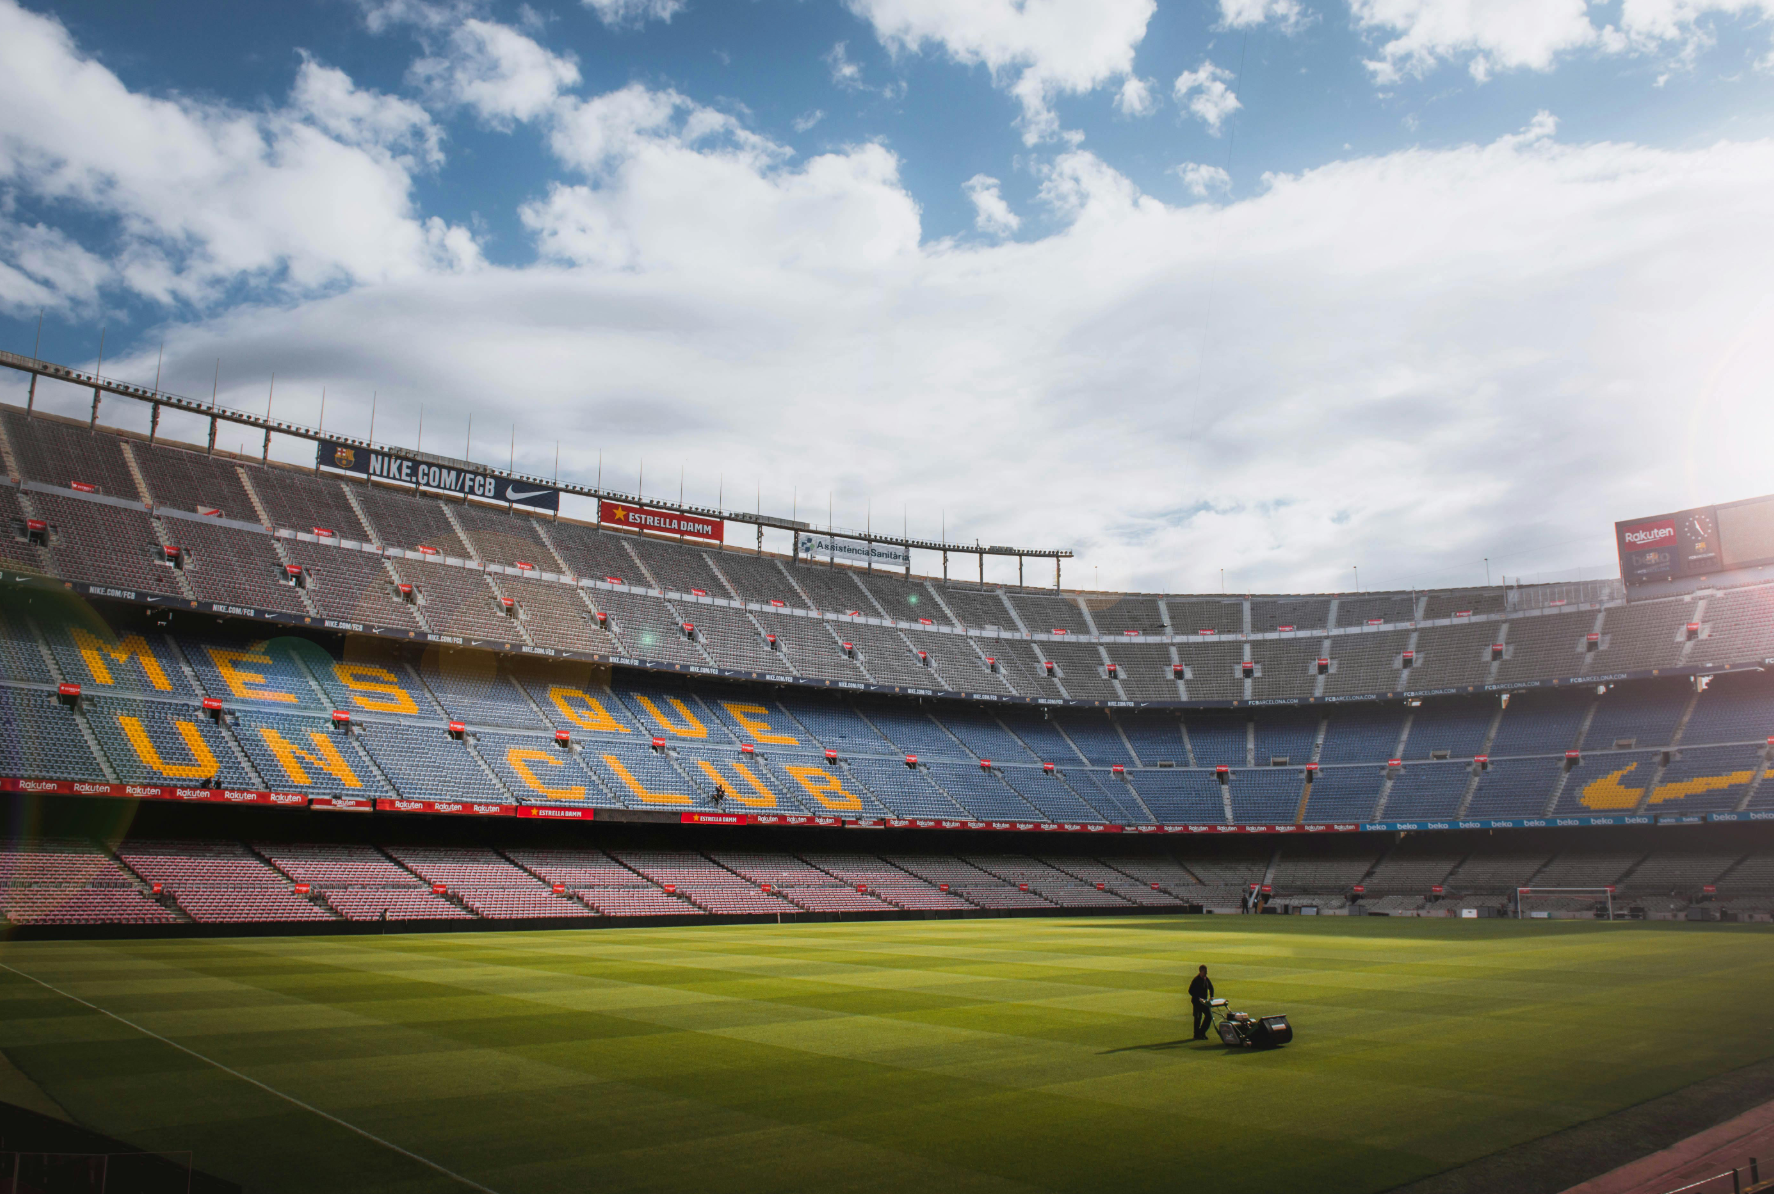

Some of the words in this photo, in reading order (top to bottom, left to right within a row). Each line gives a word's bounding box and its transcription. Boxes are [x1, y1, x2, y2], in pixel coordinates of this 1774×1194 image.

[369, 453, 496, 497] NIKE.COM/FCB
[628, 512, 678, 530] ESTRELLA
[680, 520, 712, 535] DAMM
[1625, 527, 1674, 543] Rakuten
[816, 540, 870, 557] Assistència
[870, 547, 910, 562] Sanitària
[1632, 552, 1671, 566] bo
[89, 585, 135, 600] NIKE.COM/FCB
[212, 603, 255, 617] NIKE.COM/FCB
[324, 620, 363, 632] NIKE.COM/FCB
[427, 634, 463, 645] NIKE.COM/FCB
[1570, 673, 1627, 683] FCBARCELONA.COM
[1485, 681, 1540, 691] FCBARCELONA.COM
[1403, 688, 1456, 697] FCBARCELONA.COM
[1248, 698, 1298, 706] FCBARCELONA.COM
[1325, 694, 1376, 702] FCBARCELONA.COM
[549, 687, 799, 745] QUE
[118, 716, 363, 788] UN
[507, 748, 863, 811] CLUB
[19, 780, 57, 792] Rakuten
[74, 783, 110, 794] Rakuten
[126, 786, 161, 797] Rakuten
[176, 788, 210, 799] Rakuten
[224, 791, 257, 801] Rakuten
[270, 794, 301, 804] Rakuten
[331, 799, 356, 807] Rakuten
[395, 800, 423, 810] Rakuten
[435, 803, 462, 812] Rakuten
[473, 804, 500, 814] Rakuten
[539, 809, 564, 817] ESTRELLA
[1713, 813, 1738, 821] beko
[1750, 811, 1774, 820] beko
[757, 815, 779, 824] Rakuten
[786, 816, 807, 825] Rakuten
[814, 817, 835, 825] Rakuten
[916, 820, 935, 828] Rakuten
[1491, 820, 1513, 828] beko
[1523, 819, 1546, 827] beko
[1557, 818, 1579, 826] beko
[1590, 817, 1613, 825] beko
[1625, 816, 1648, 824] beko
[992, 822, 1010, 830] Rakuten
[1138, 825, 1156, 833] Rakuten
[1164, 825, 1183, 833] Rakuten
[1189, 825, 1208, 833] Rakuten
[1216, 825, 1237, 833] Rakuten
[1246, 825, 1267, 833] Rakuten
[1366, 823, 1386, 831] beko
[1396, 822, 1417, 830] beko
[1459, 821, 1480, 829] beko
